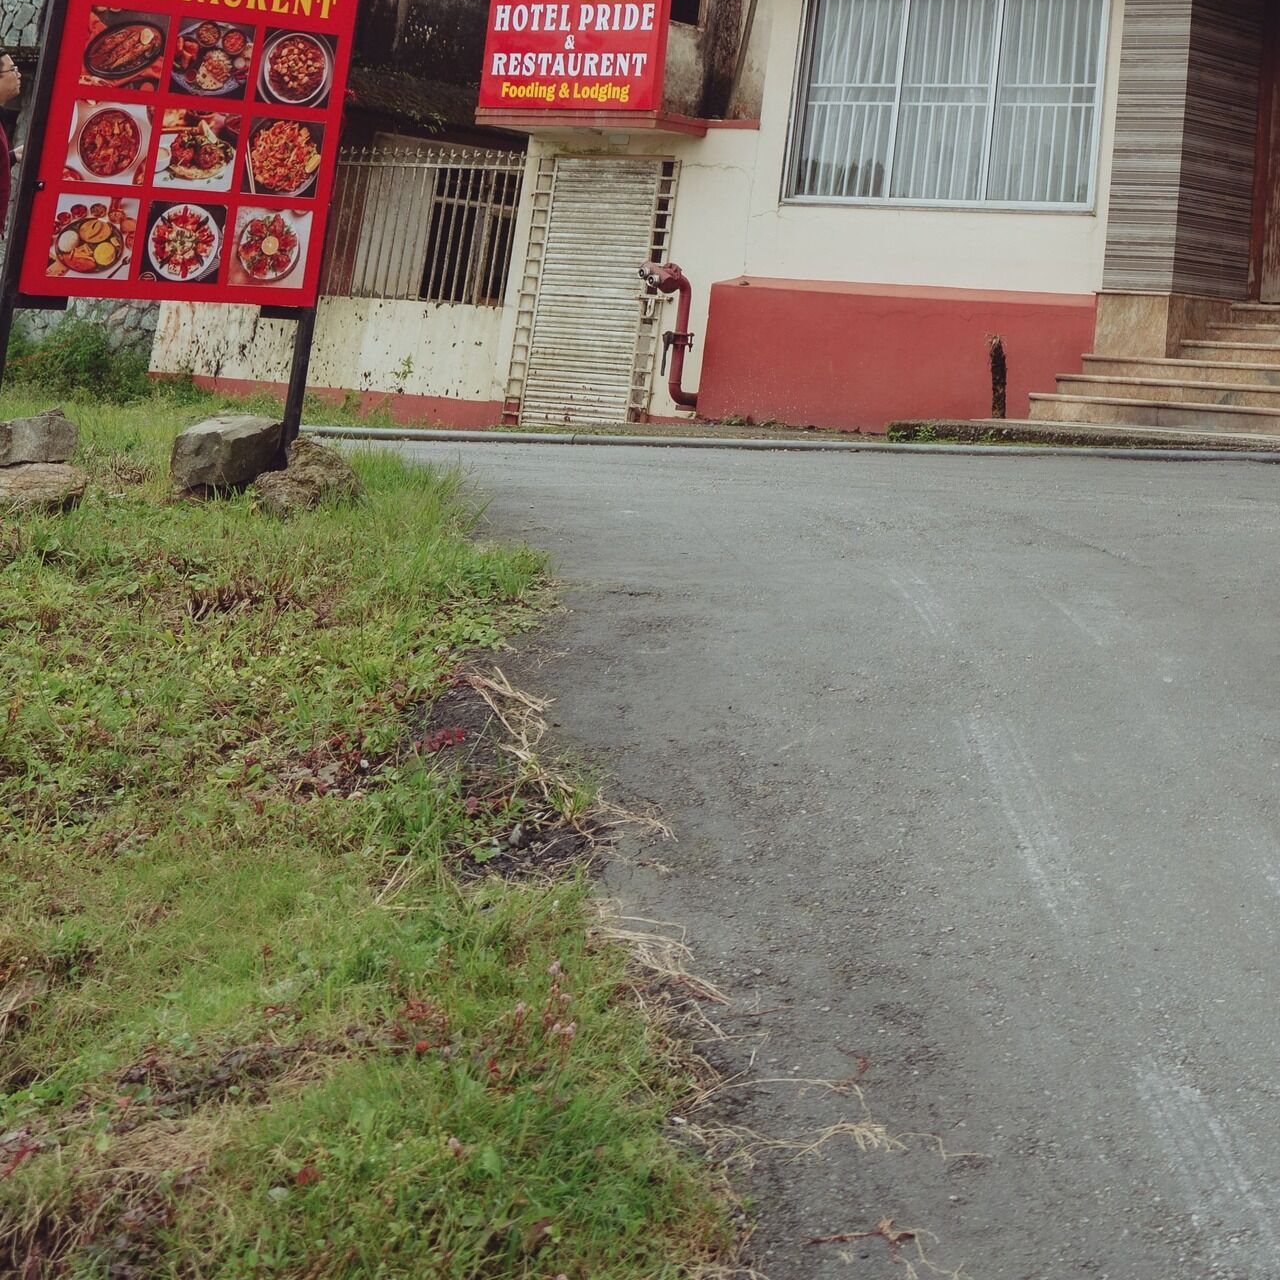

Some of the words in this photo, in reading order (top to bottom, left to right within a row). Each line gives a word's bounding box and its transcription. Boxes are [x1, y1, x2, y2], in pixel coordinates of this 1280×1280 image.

[494, 4, 571, 32] HOTEL
[578, 3, 655, 31] PRIDE
[564, 34, 575, 50] &
[491, 53, 648, 77] RESTAURENT
[501, 81, 556, 102] Fooding
[558, 83, 570, 99] &
[573, 82, 630, 103] Lodging
